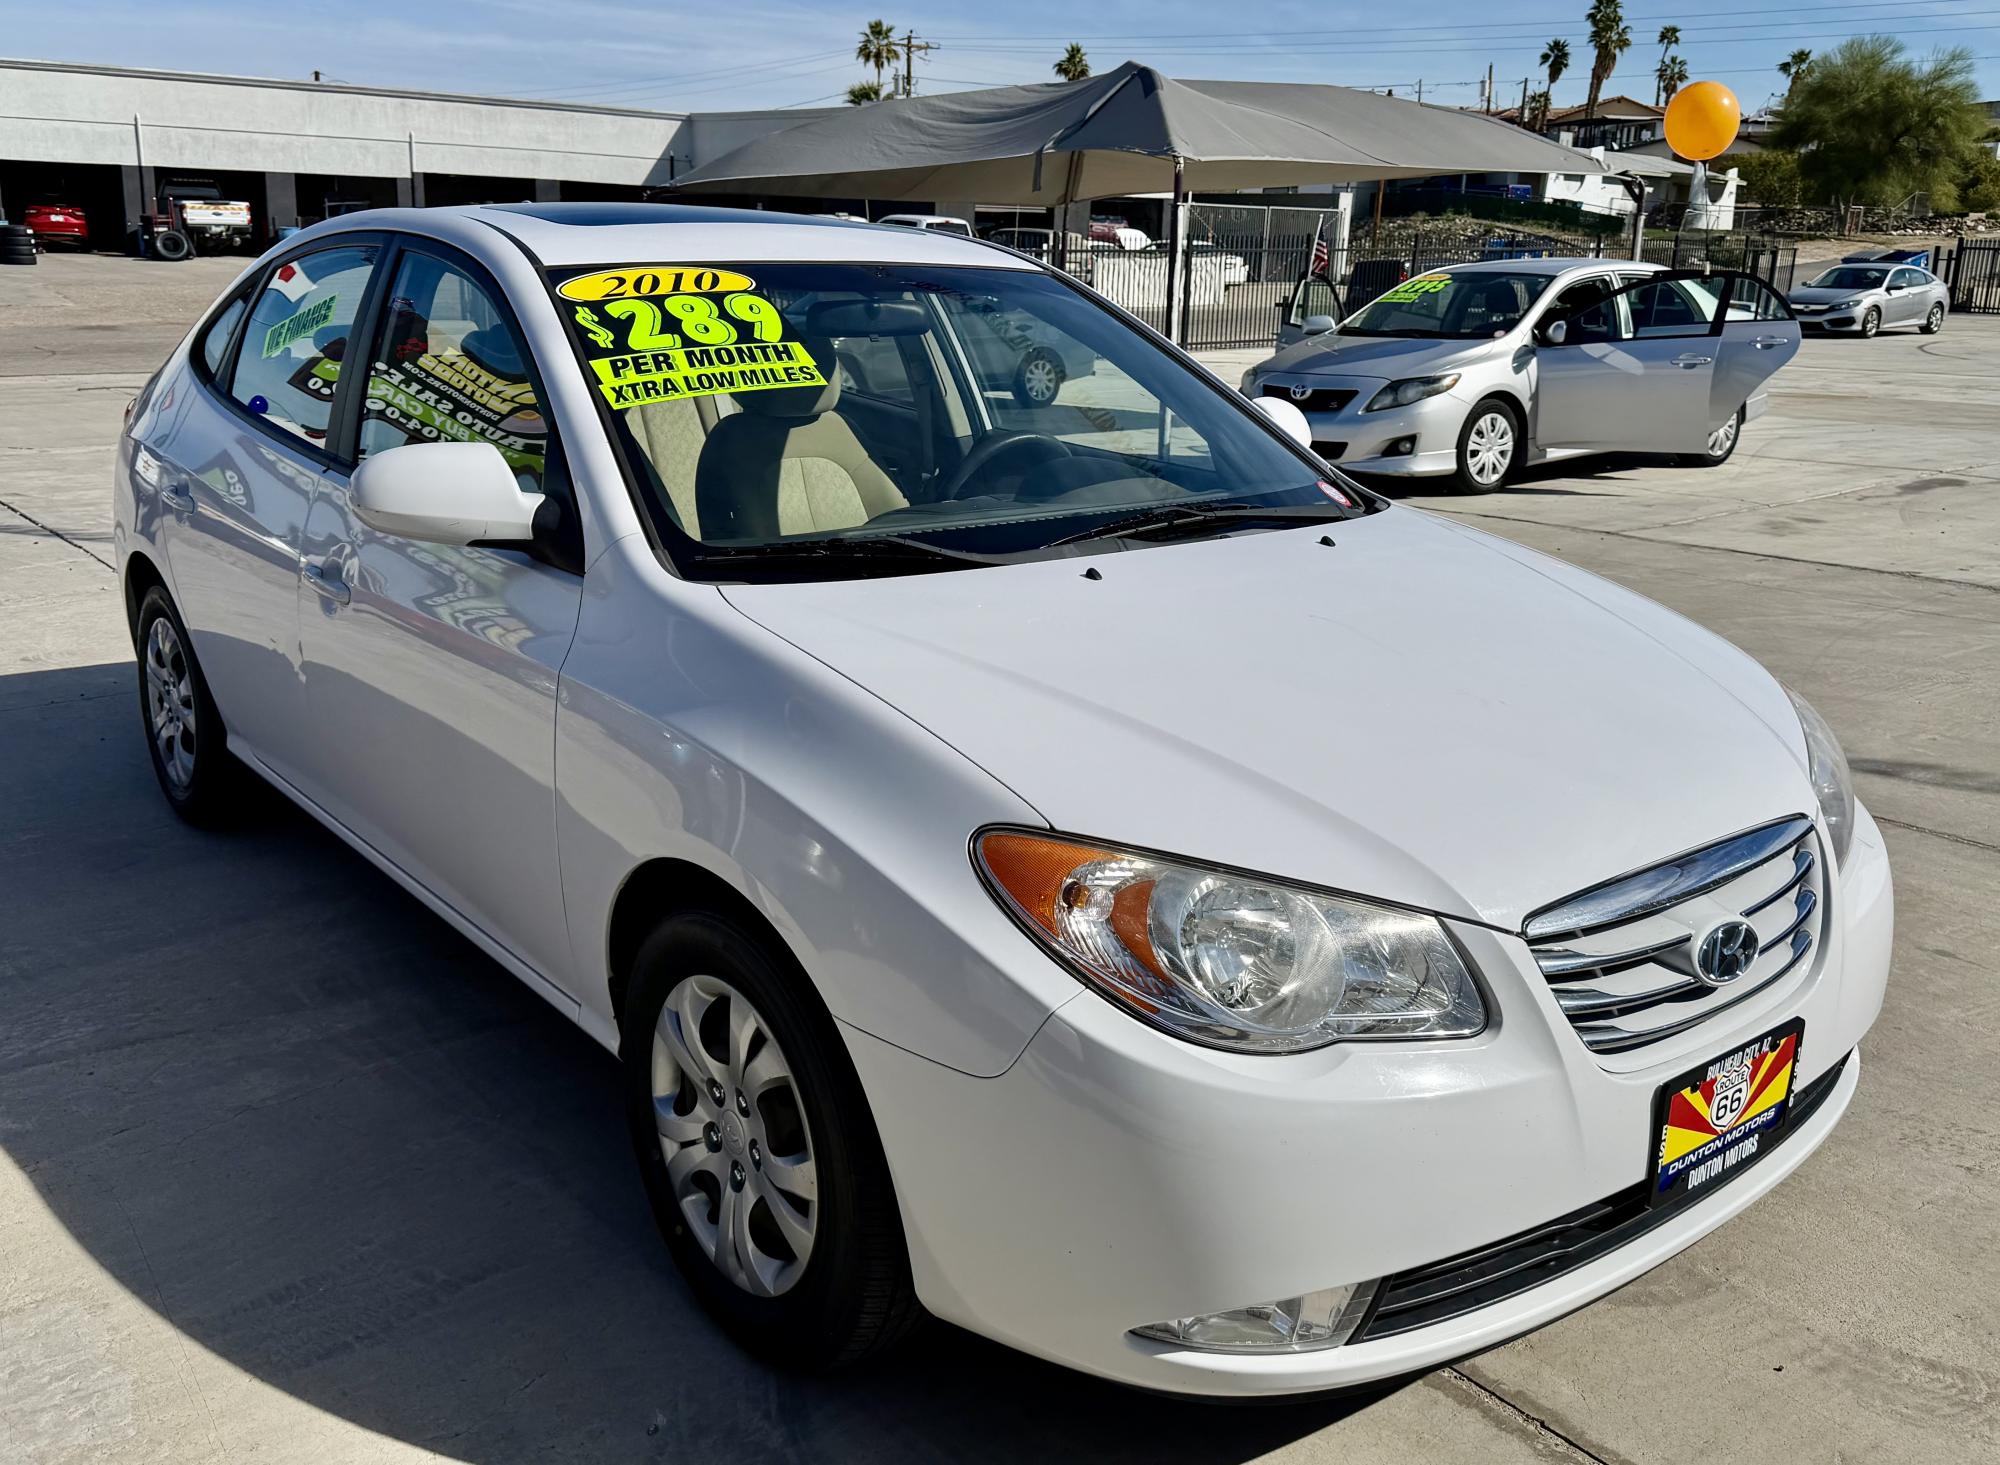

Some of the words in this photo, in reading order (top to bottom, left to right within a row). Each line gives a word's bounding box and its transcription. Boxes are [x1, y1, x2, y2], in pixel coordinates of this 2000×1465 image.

[601, 271, 721, 298] 2010
[266, 321, 287, 353] WE
[283, 294, 337, 346] FINANCE
[575, 292, 783, 351] $289
[609, 352, 676, 380] PER
[687, 342, 797, 369] MONTH
[610, 376, 683, 405] XTRA
[684, 370, 736, 393] LOW
[740, 364, 817, 387] MILES
[1706, 1052, 1743, 1081] BULLHEAD
[1761, 1036, 1772, 1053] AZ
[1719, 1070, 1748, 1092] ROUTE
[1715, 1087, 1743, 1121] 66
[1668, 1135, 1724, 1175] DUNTON
[1724, 1107, 1776, 1145] MOTORS
[1687, 1155, 1724, 1190] DUNTON
[1723, 1133, 1759, 1171] MOTORS
